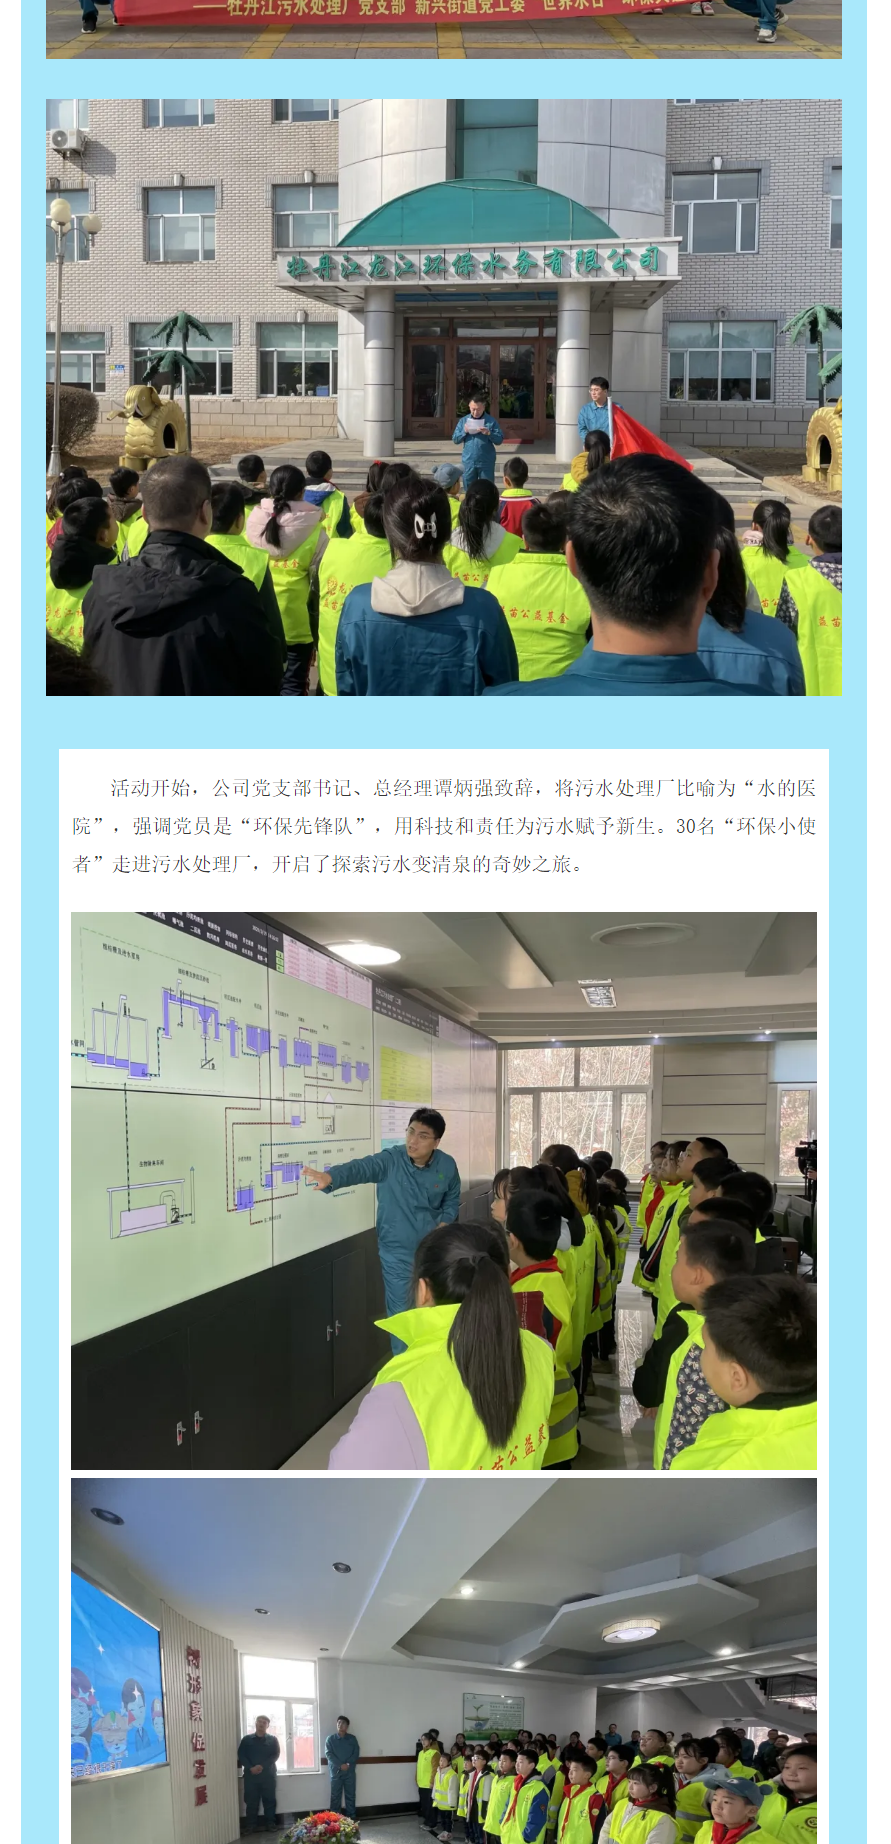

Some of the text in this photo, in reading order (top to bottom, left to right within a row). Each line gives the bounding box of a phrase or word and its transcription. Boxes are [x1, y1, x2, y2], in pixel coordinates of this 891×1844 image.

[285, 244, 661, 278] 牡丹江龙江环保水务有限公司
